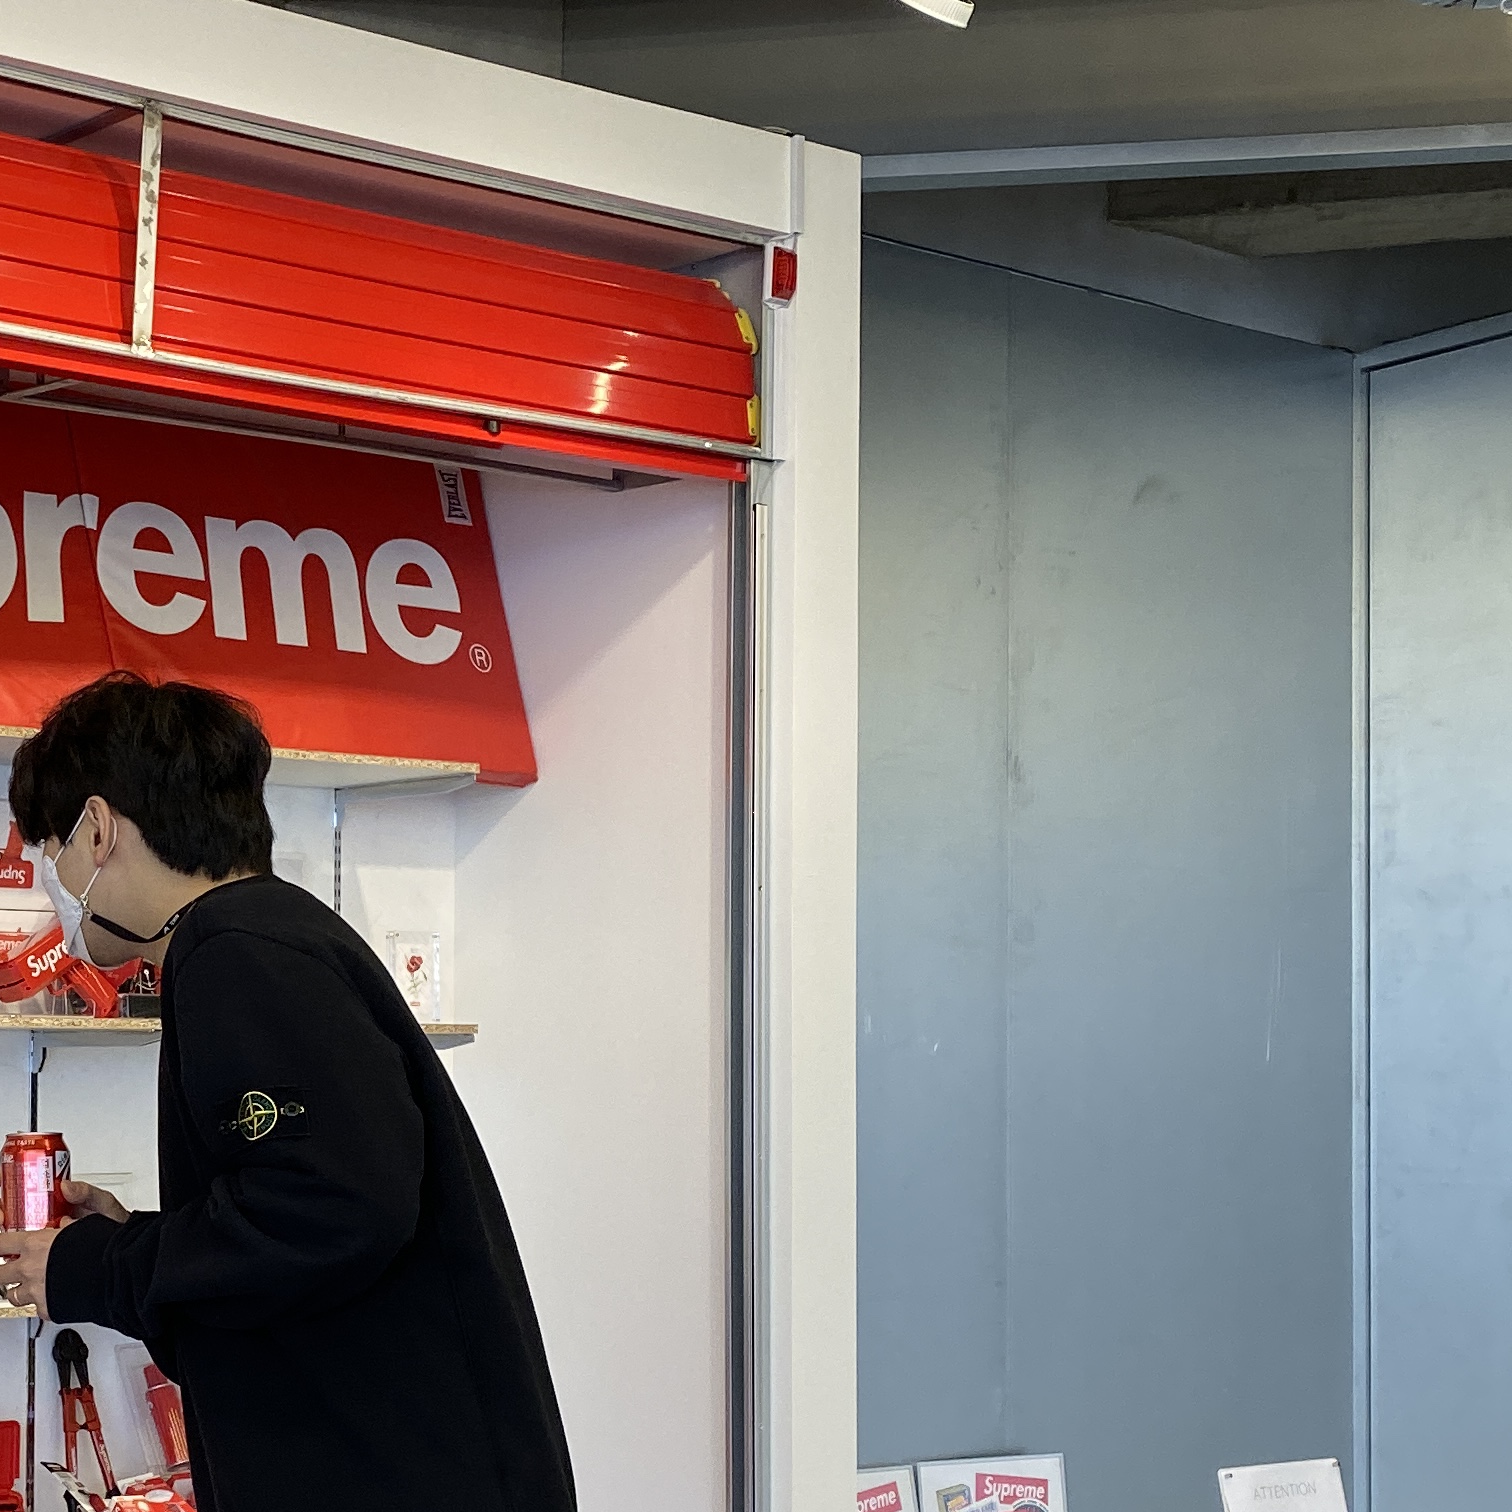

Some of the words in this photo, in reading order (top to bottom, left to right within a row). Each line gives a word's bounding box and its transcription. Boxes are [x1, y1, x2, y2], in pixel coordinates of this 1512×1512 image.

[438, 469, 468, 520] EVERLAST
[983, 1476, 1046, 1501] Supreme
[1253, 1481, 1317, 1501] ATTENTION
